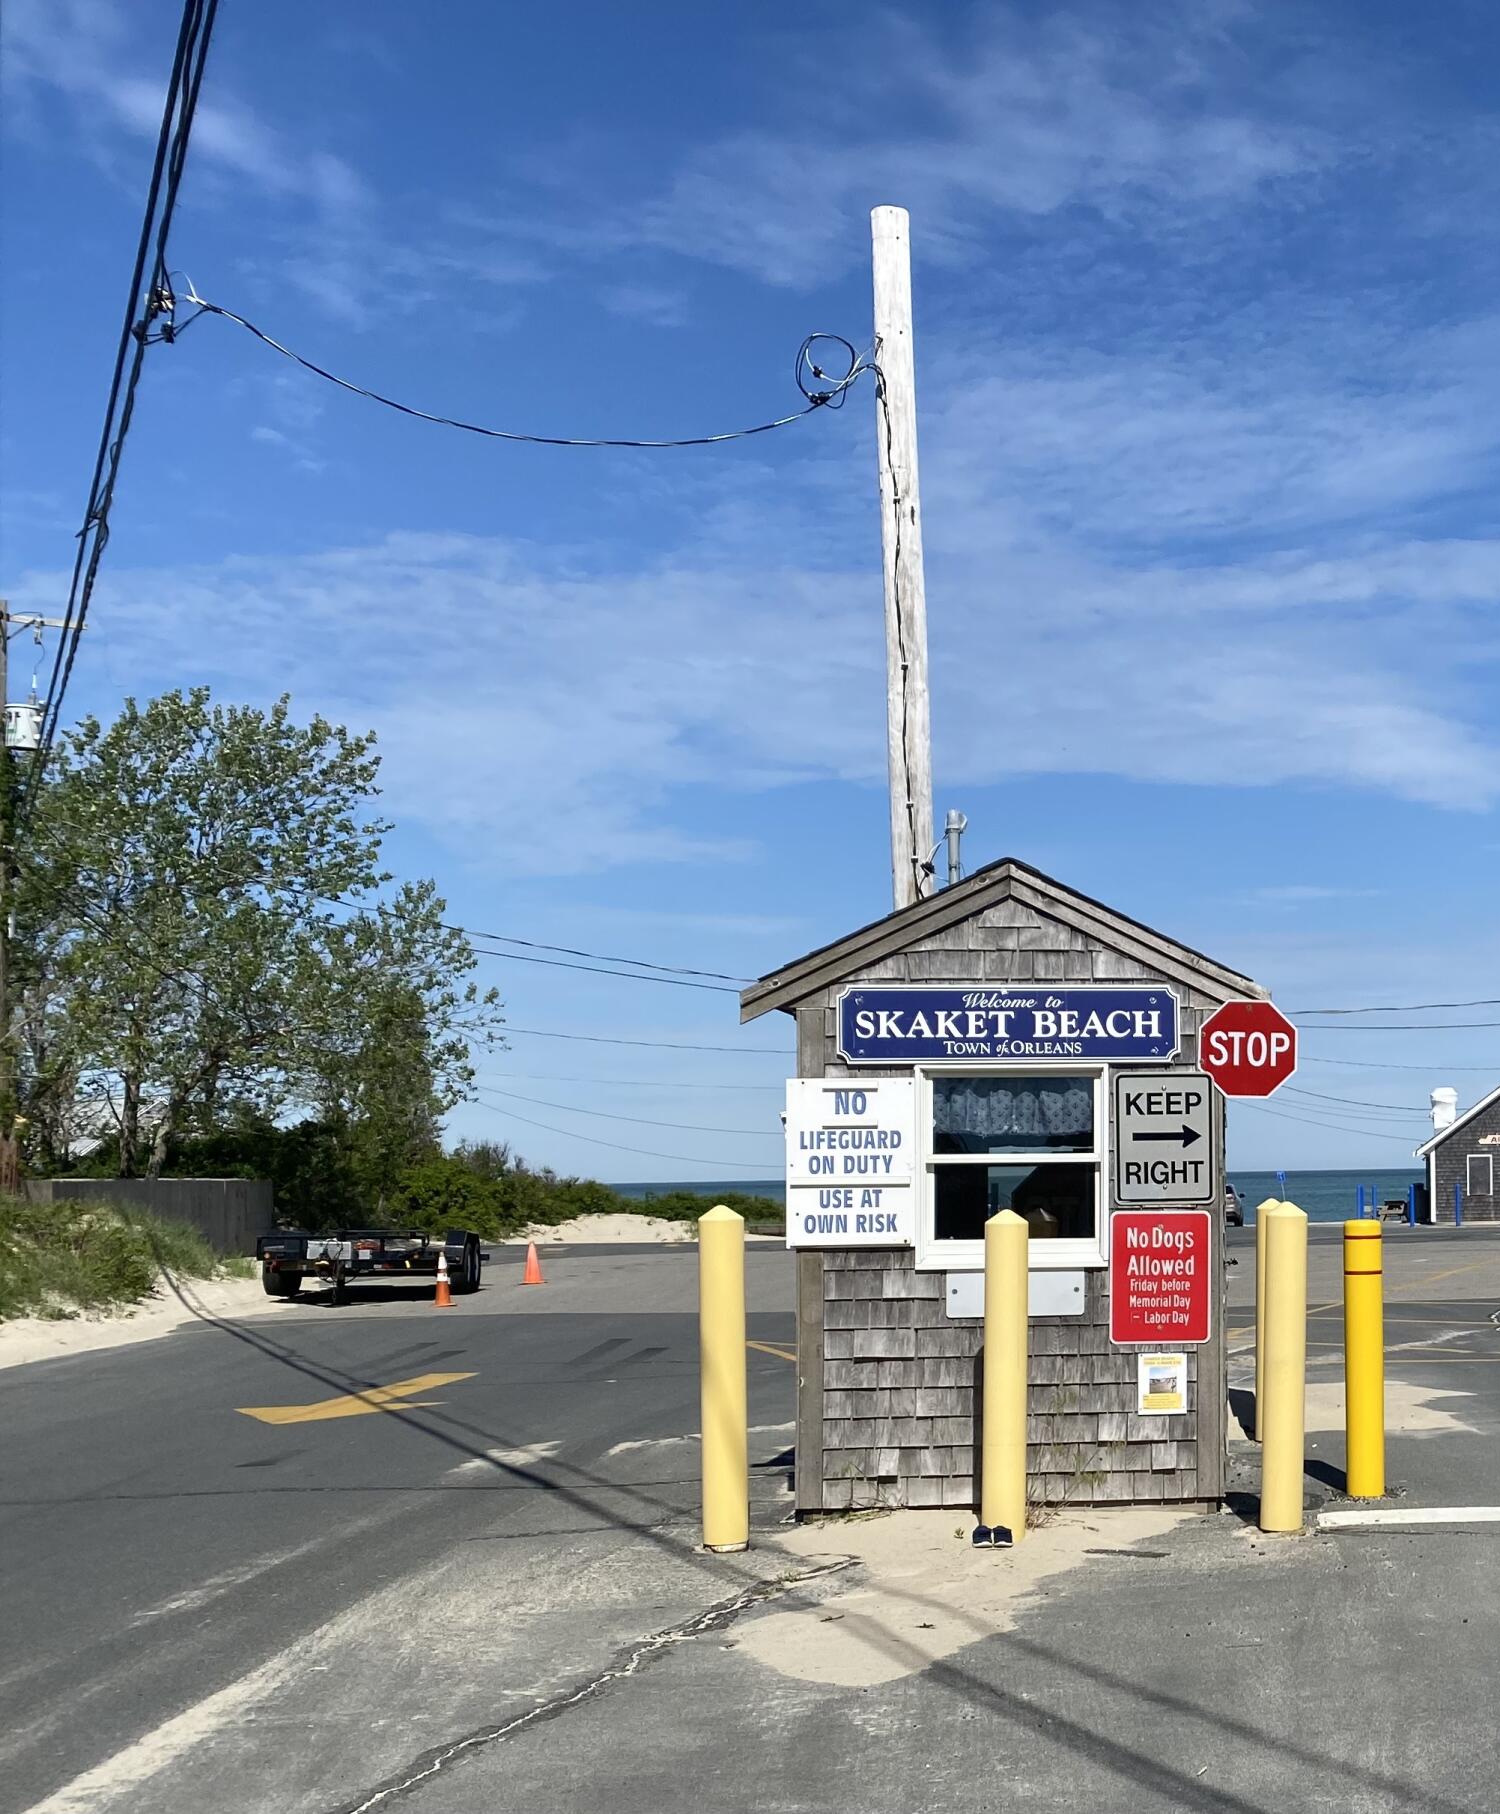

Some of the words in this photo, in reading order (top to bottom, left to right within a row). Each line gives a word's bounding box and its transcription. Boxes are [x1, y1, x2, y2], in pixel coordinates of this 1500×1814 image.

[962, 993, 1037, 1008] Welcome
[1045, 994, 1064, 1008] to
[855, 1010, 1014, 1039] SKAKET
[1032, 1010, 1162, 1039] BEACH
[943, 1041, 990, 1054] TOWN
[996, 1040, 1009, 1057] of
[1010, 1041, 1082, 1055] ORLEANS
[1208, 1030, 1290, 1067] STOP
[834, 1089, 867, 1115] NO
[1125, 1092, 1202, 1116] KEEP
[800, 1130, 902, 1150] LIFEGUARD
[808, 1155, 835, 1175] ON
[843, 1154, 893, 1174] DUTY
[1125, 1161, 1204, 1185] RIGHT
[819, 1189, 853, 1209] USE
[860, 1189, 883, 1208] AT
[804, 1214, 848, 1234] OWN
[856, 1213, 898, 1233] RISK
[1127, 1227, 1149, 1248] No
[1152, 1226, 1194, 1254] Dogs
[1126, 1254, 1195, 1276] Allowed
[1130, 1279, 1158, 1294] Friday
[1161, 1278, 1191, 1291] before
[1129, 1295, 1172, 1308] Memorial
[1173, 1295, 1191, 1310] Day
[1144, 1311, 1170, 1324] Labor
[1172, 1311, 1190, 1326] Day
